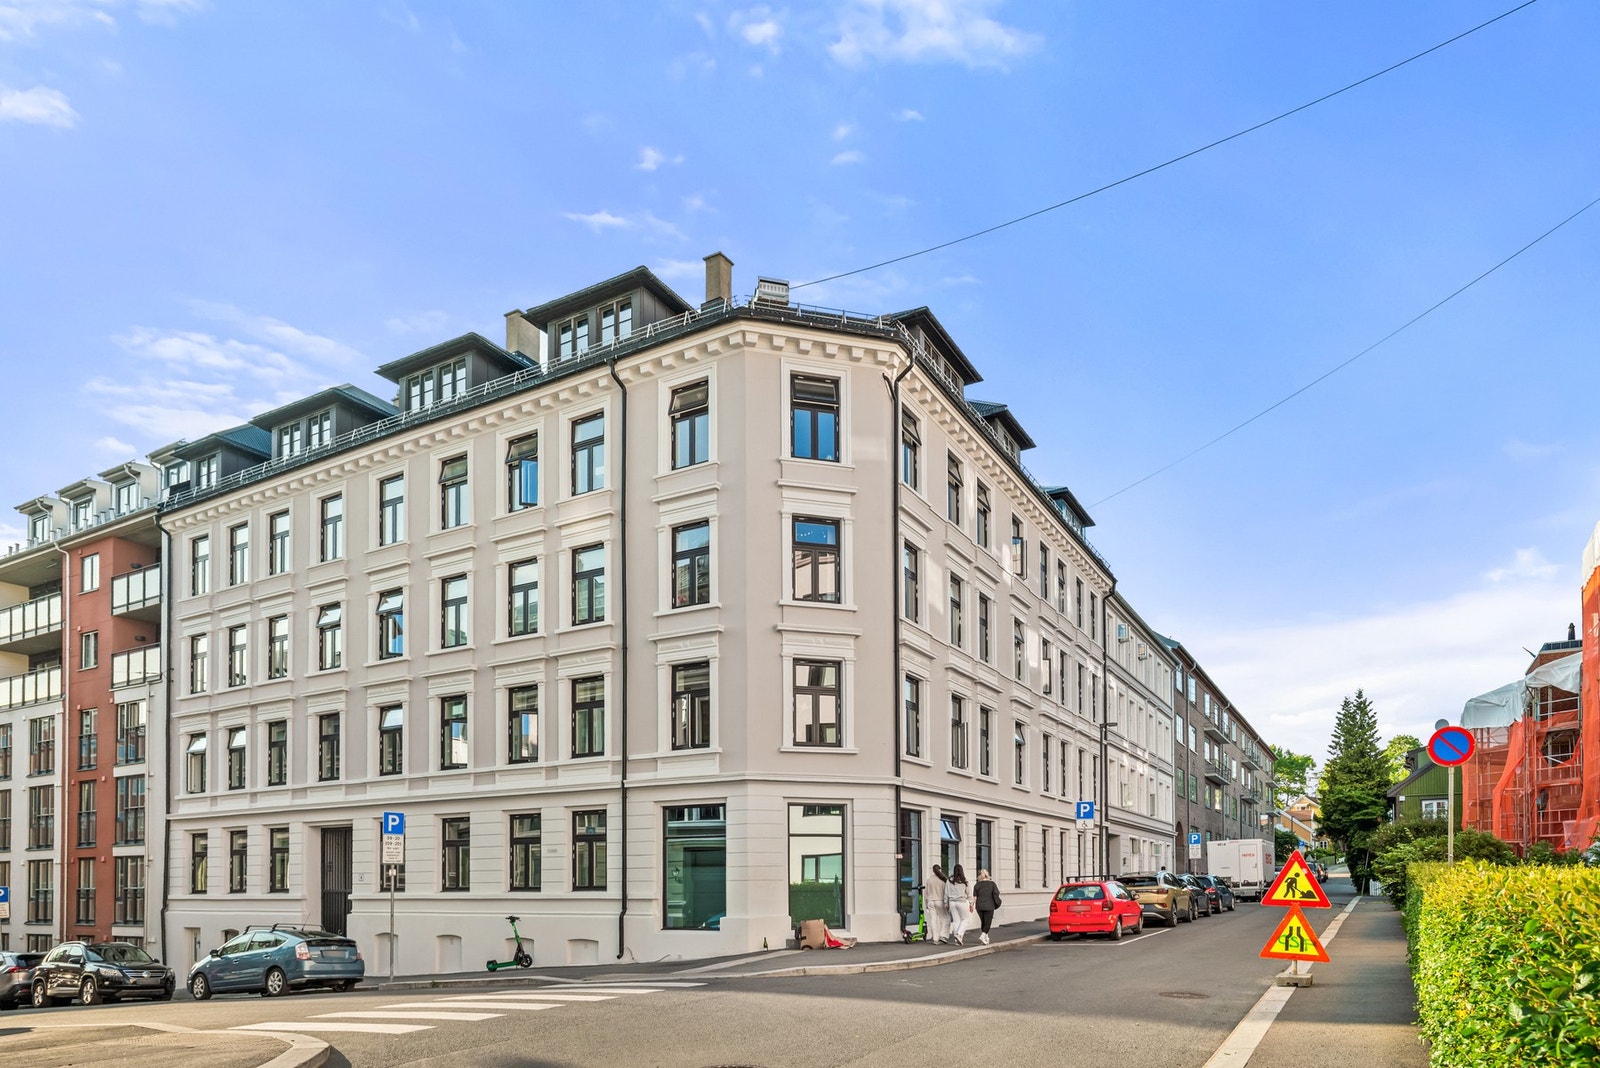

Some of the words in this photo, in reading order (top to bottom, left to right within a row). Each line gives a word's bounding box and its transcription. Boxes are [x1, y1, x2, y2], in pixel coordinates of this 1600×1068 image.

[1080, 803, 1090, 817] P
[388, 814, 400, 832] P
[1191, 834, 1198, 843] P
